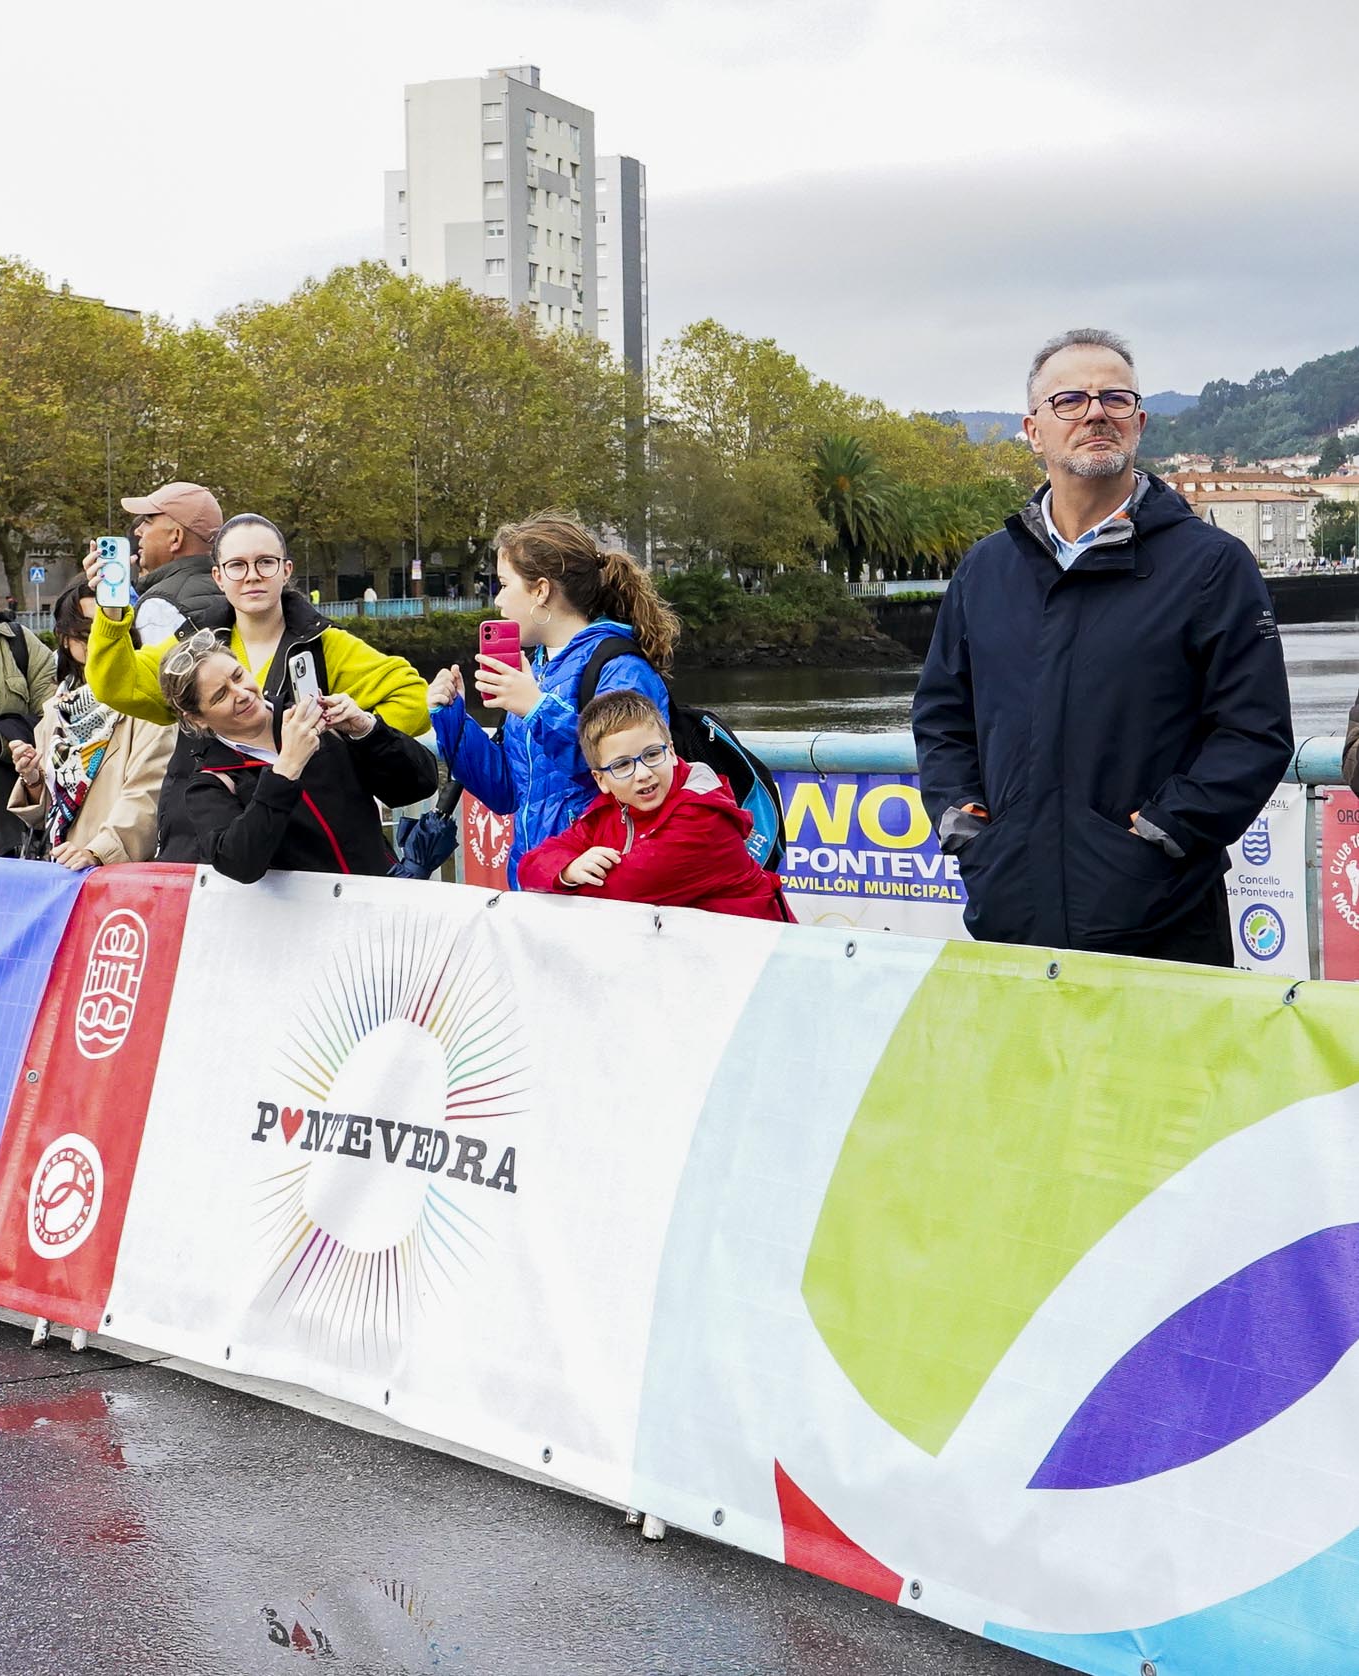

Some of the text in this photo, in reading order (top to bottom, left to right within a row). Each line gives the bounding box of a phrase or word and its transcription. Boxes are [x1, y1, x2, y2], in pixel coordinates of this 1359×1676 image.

[491, 840, 510, 869] SPORT
[786, 846, 962, 881] PONTEVE
[1329, 842, 1353, 875] CLUB
[781, 875, 962, 900] PAVILLÓN MUNICIPAL
[1226, 887, 1294, 899] de Pontevedra
[1238, 874, 1281, 886] Concello
[44, 1150, 93, 1182] DEPORTE
[33, 1194, 91, 1244] PONTEVEDRA
